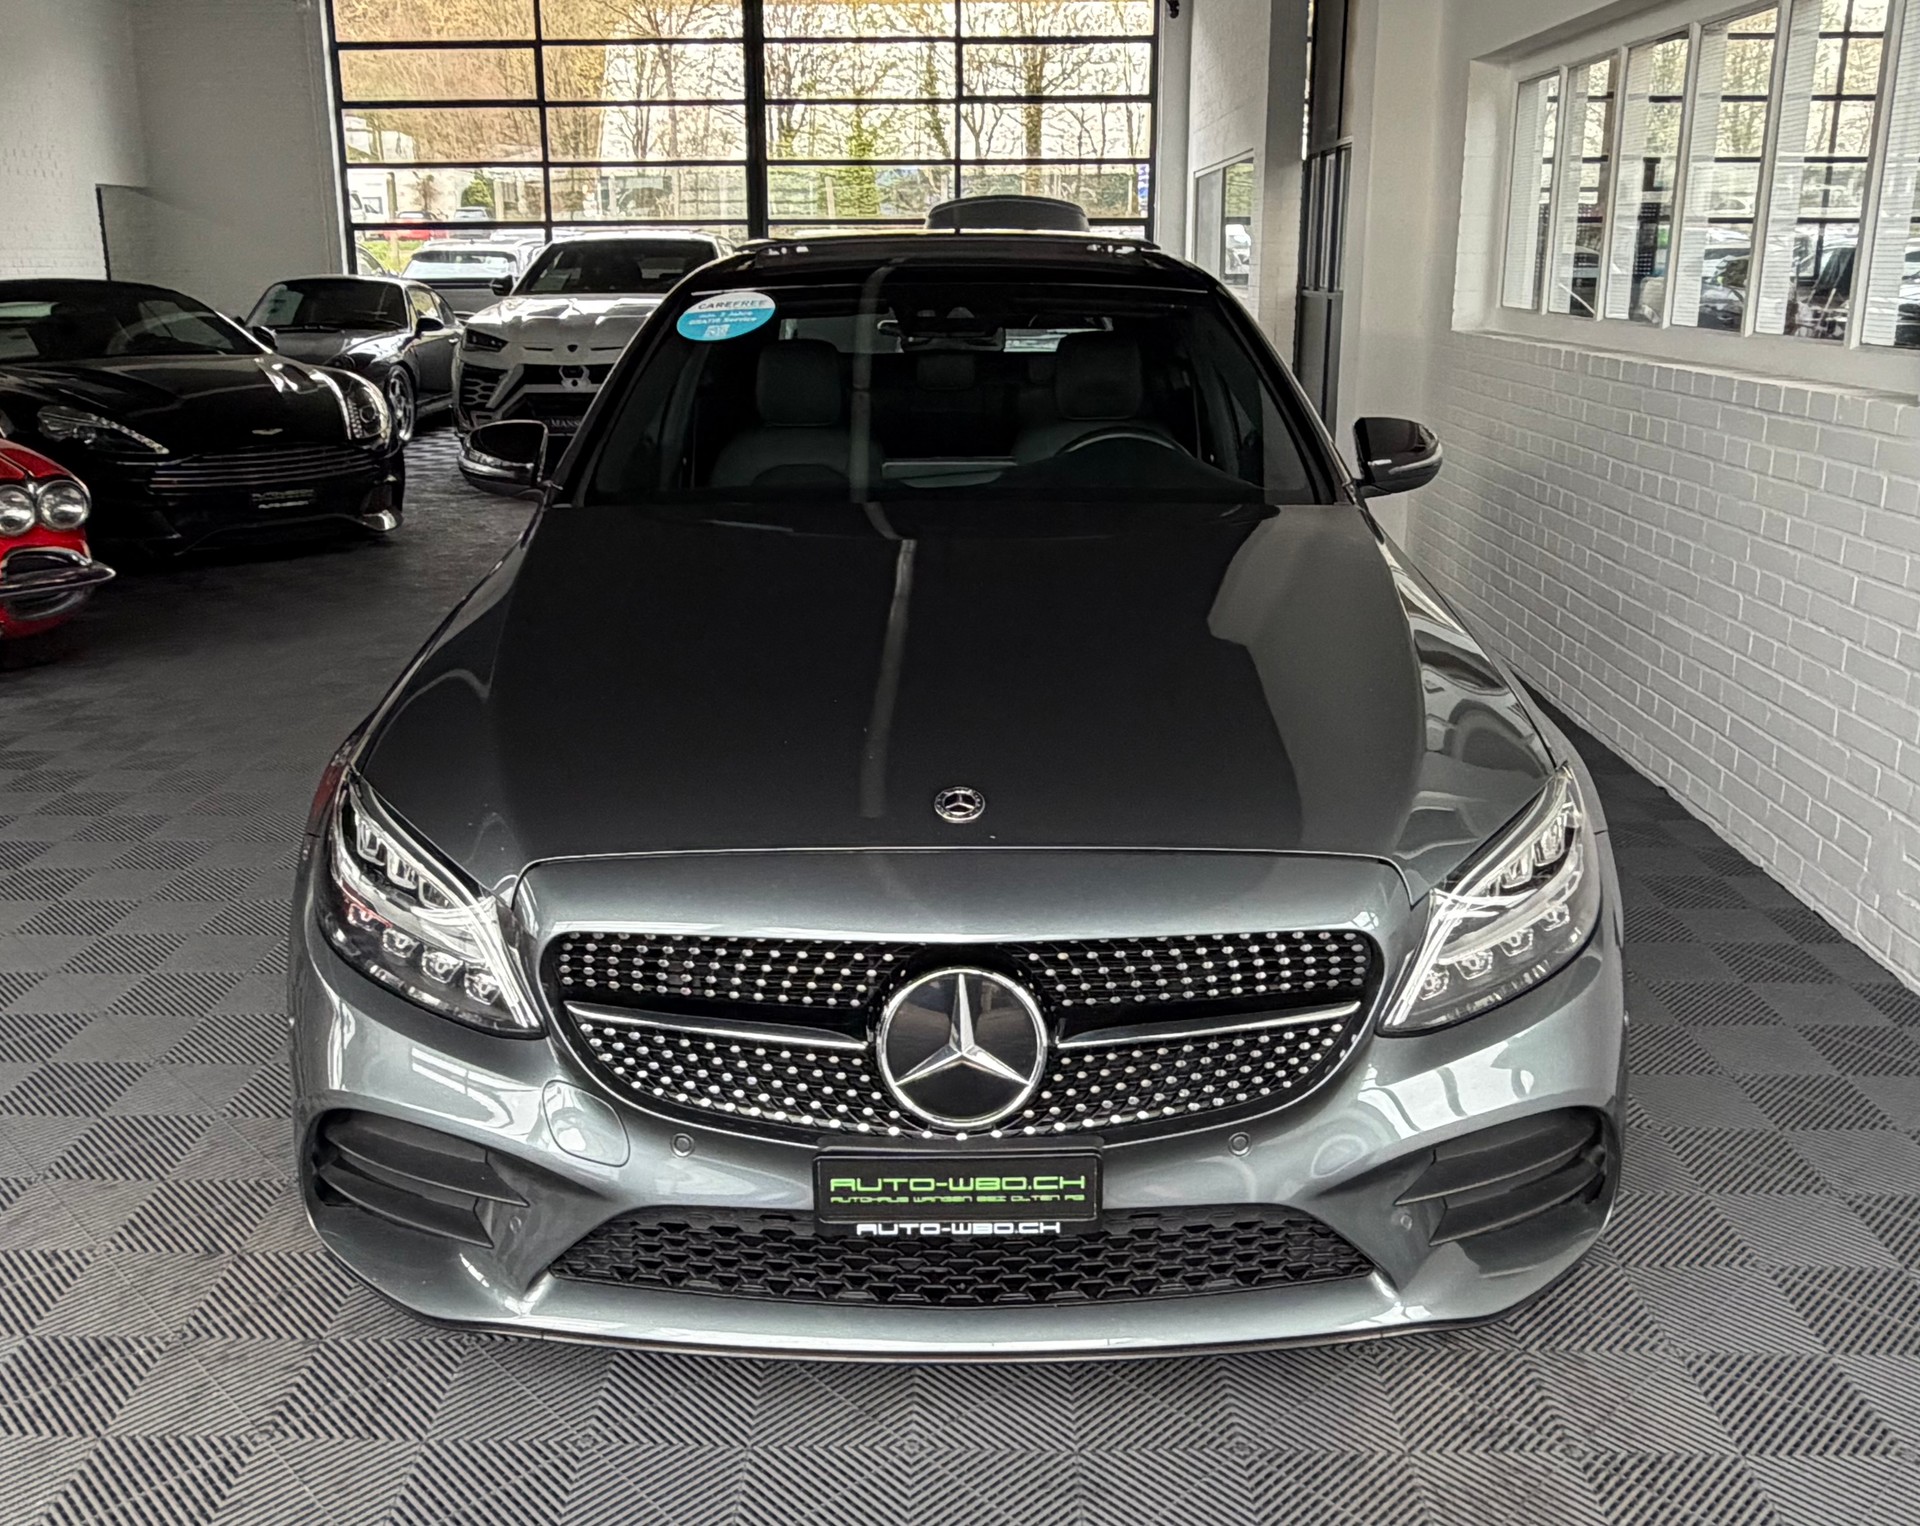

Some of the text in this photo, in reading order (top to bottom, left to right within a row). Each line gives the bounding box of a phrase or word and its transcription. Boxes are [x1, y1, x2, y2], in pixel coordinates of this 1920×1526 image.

[698, 300, 767, 310] CAREFREE
[830, 1175, 1086, 1192] AUTO-WBO.CH
[856, 1221, 1061, 1235] AUTO-WBO.CH
